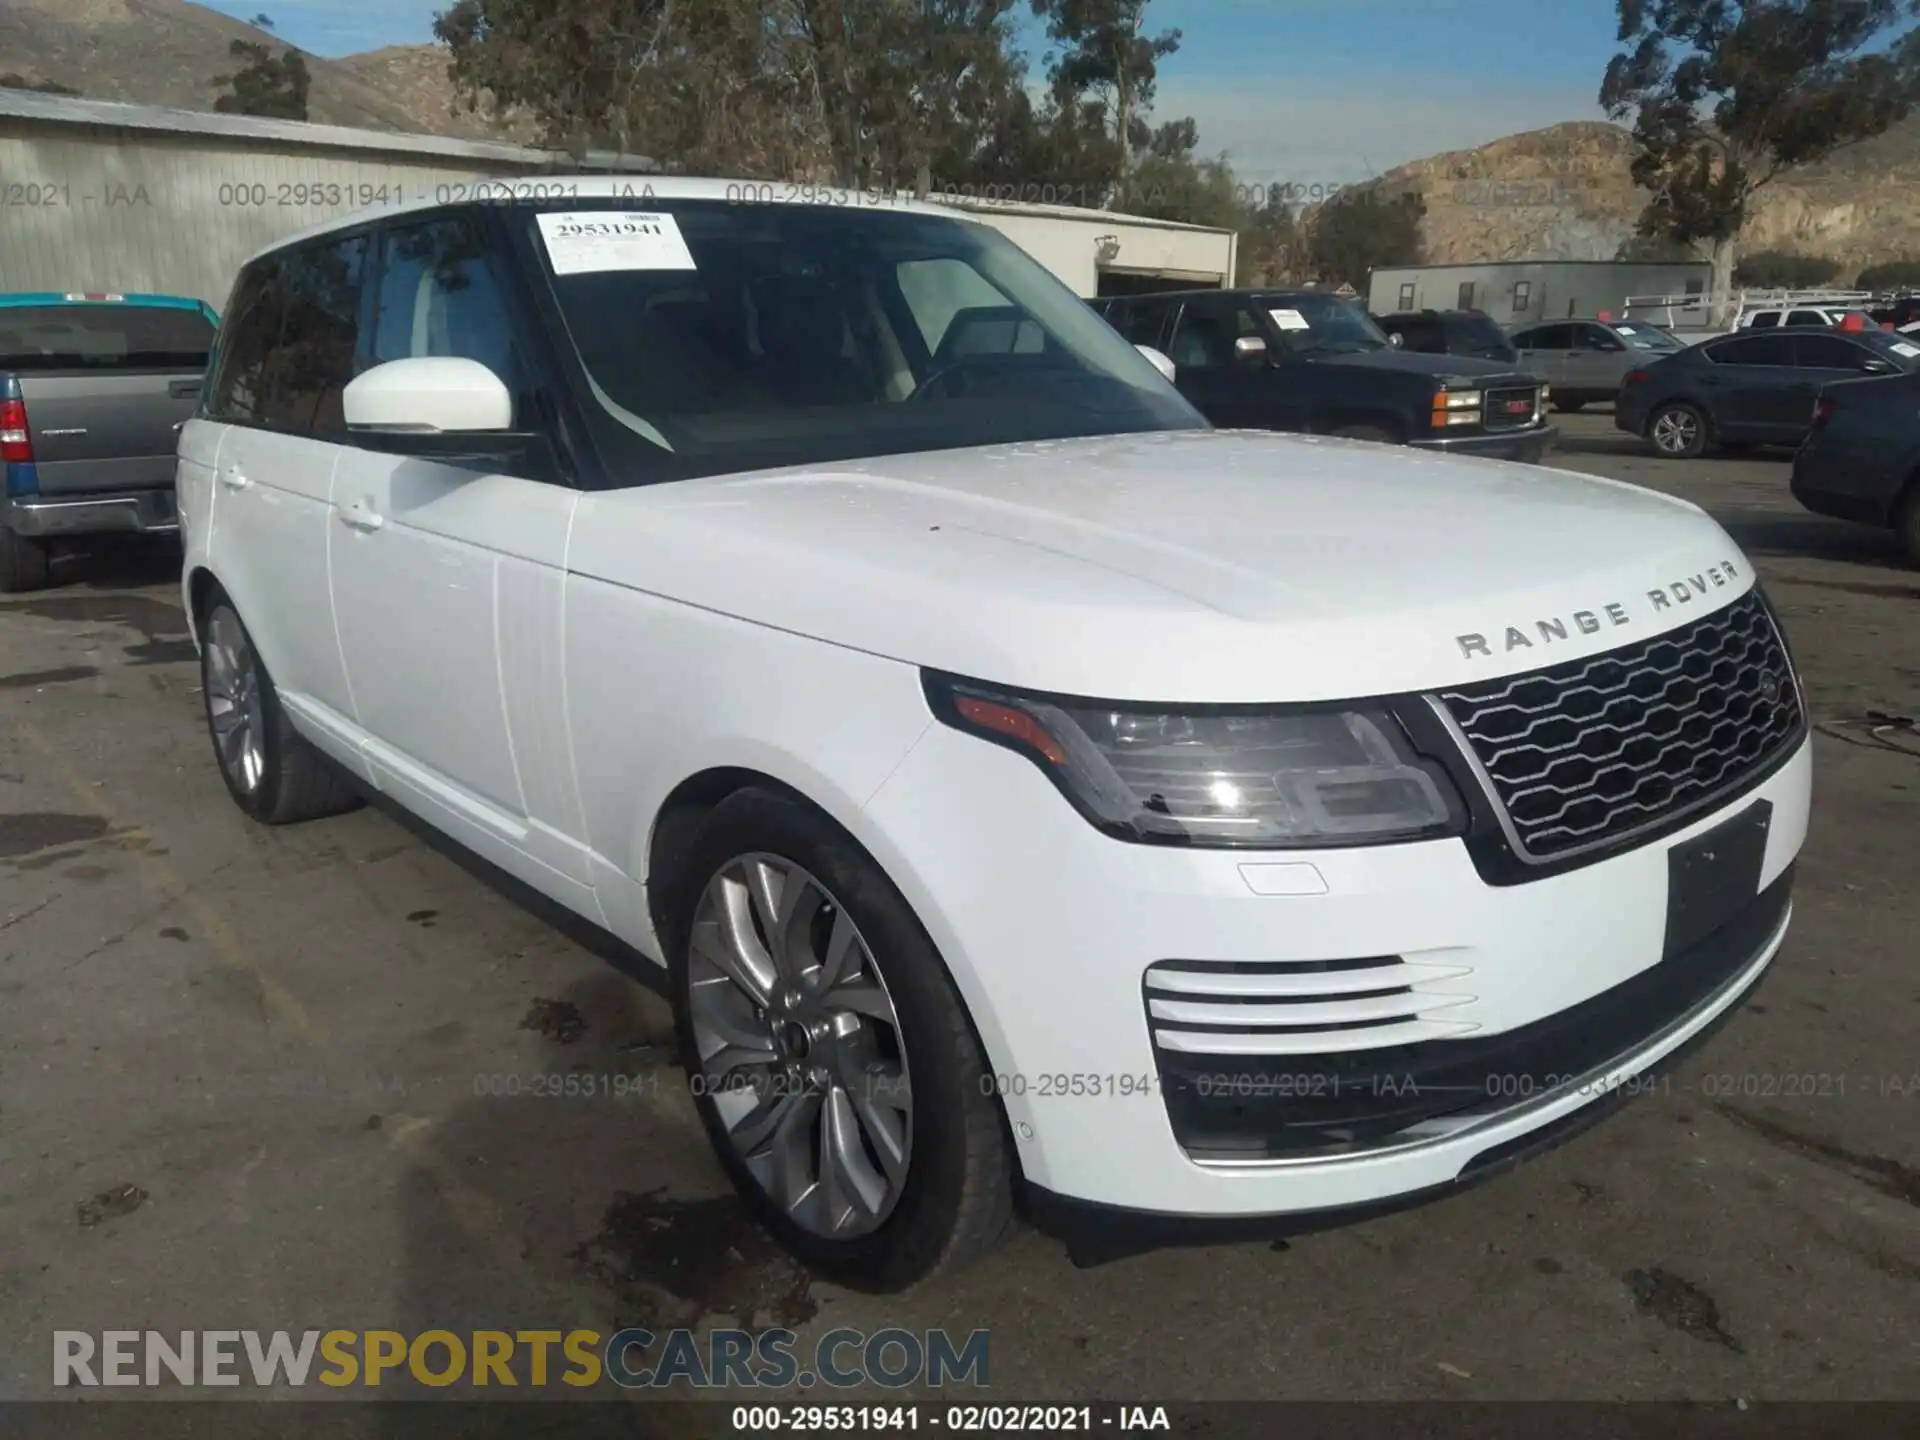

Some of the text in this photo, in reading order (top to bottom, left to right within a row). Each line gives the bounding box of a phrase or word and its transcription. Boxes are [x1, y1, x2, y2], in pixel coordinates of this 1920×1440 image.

[556, 222, 664, 238] 29531941
[1455, 559, 1739, 660] RANGE ROVER
